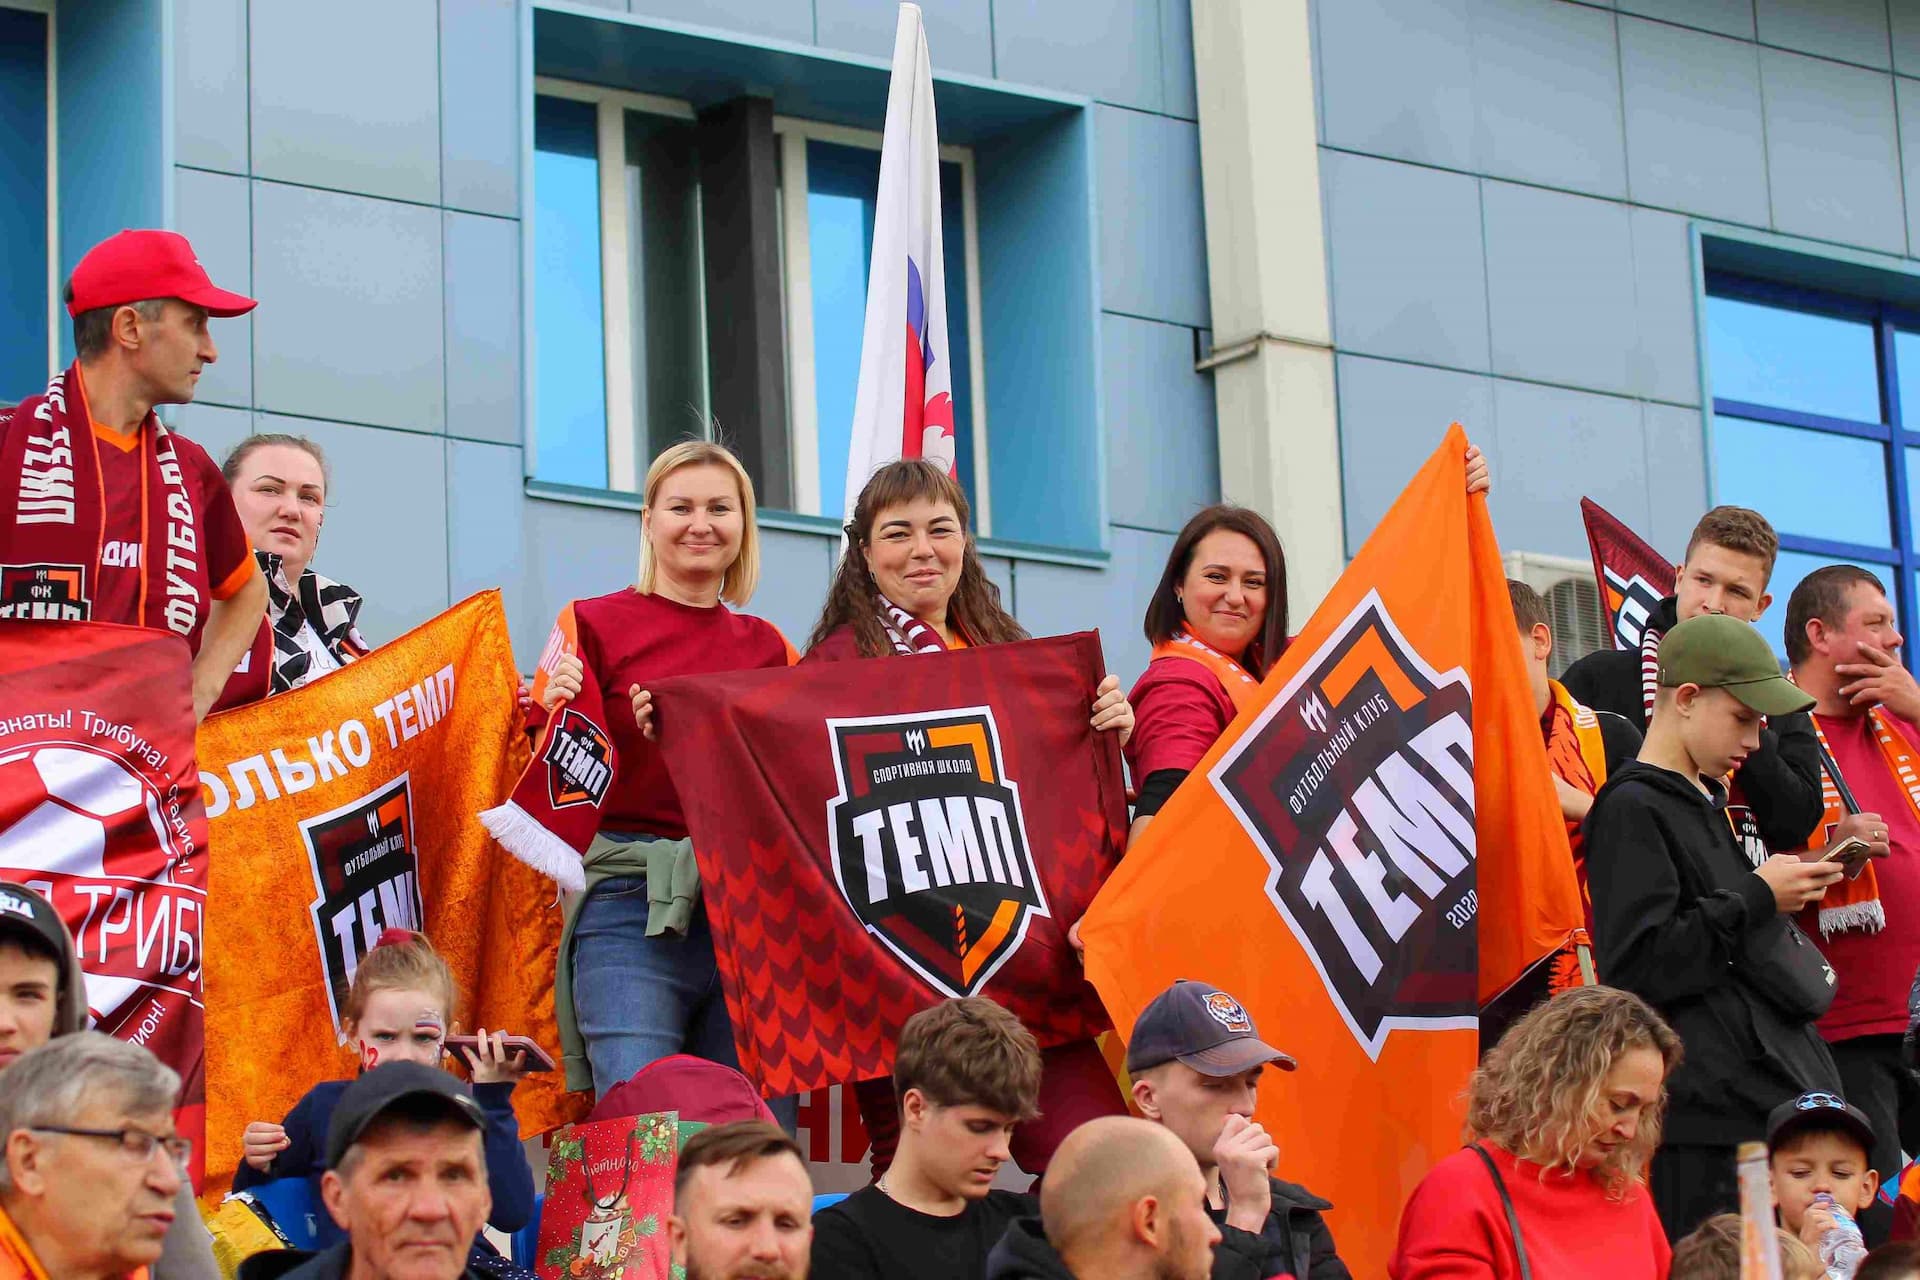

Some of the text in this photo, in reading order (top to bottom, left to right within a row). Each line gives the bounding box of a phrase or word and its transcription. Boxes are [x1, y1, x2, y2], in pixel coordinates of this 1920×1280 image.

[31, 585, 52, 598] ФК
[373, 663, 454, 750] ТЕМП
[81, 710, 168, 771] Трибуна!
[553, 731, 608, 796] ТЕМП
[580, 736, 595, 751] ФК
[873, 759, 972, 784] СПОРТИВНАЯ ШКОЛА
[1288, 692, 1390, 815] ФУТБОЛЬНЫЙ КЛУБ
[344, 836, 390, 876] ФУТБОЛЬНЫЙ
[852, 796, 1024, 904] ТЕМП
[1299, 711, 1477, 987] ТЕМП
